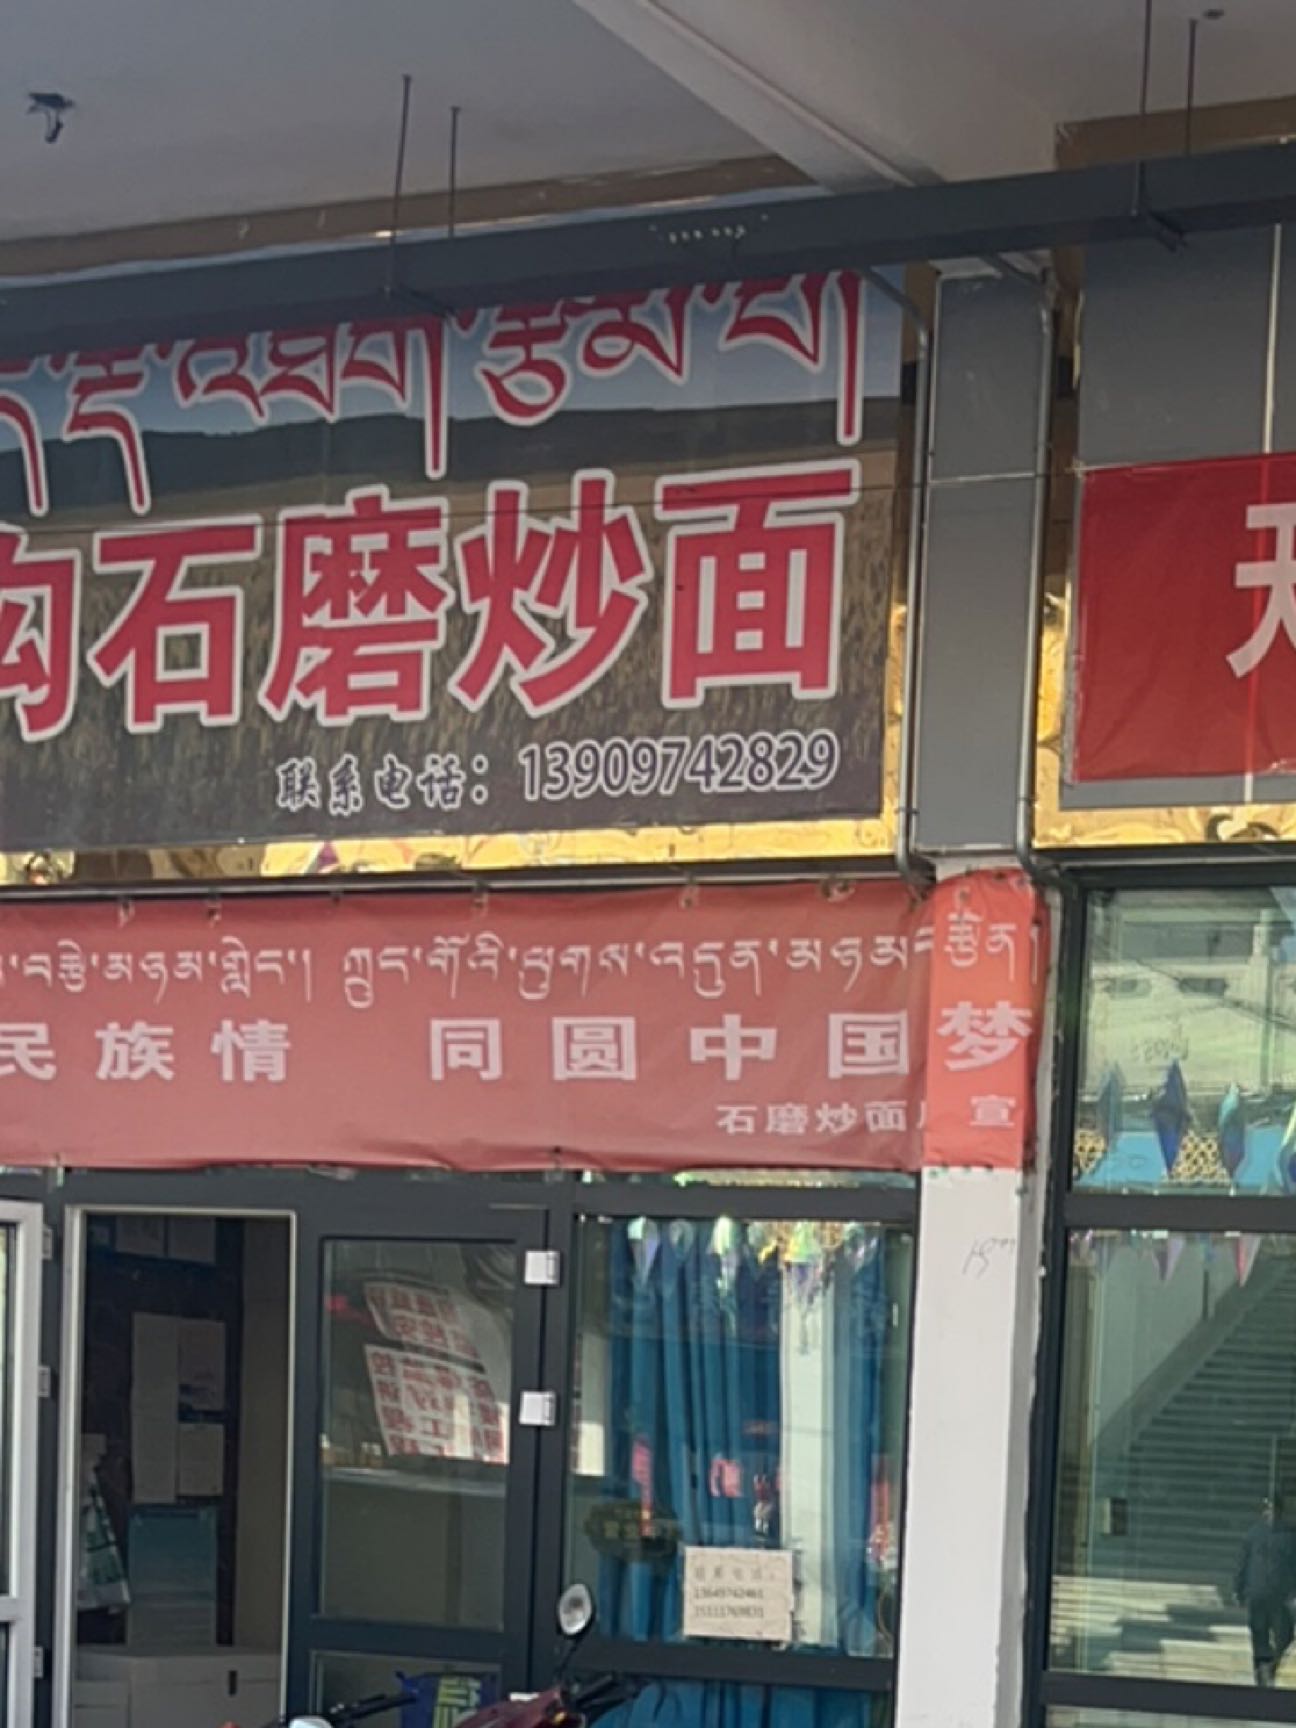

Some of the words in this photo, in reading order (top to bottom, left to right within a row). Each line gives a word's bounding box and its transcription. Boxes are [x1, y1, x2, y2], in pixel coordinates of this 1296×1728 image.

[518, 730, 841, 801] 13909742829
[0, 1018, 291, 1082] 民族情
[429, 1000, 1033, 1082] 同圆中国梦
[715, 1094, 1017, 1136] 石磨炒面宣
